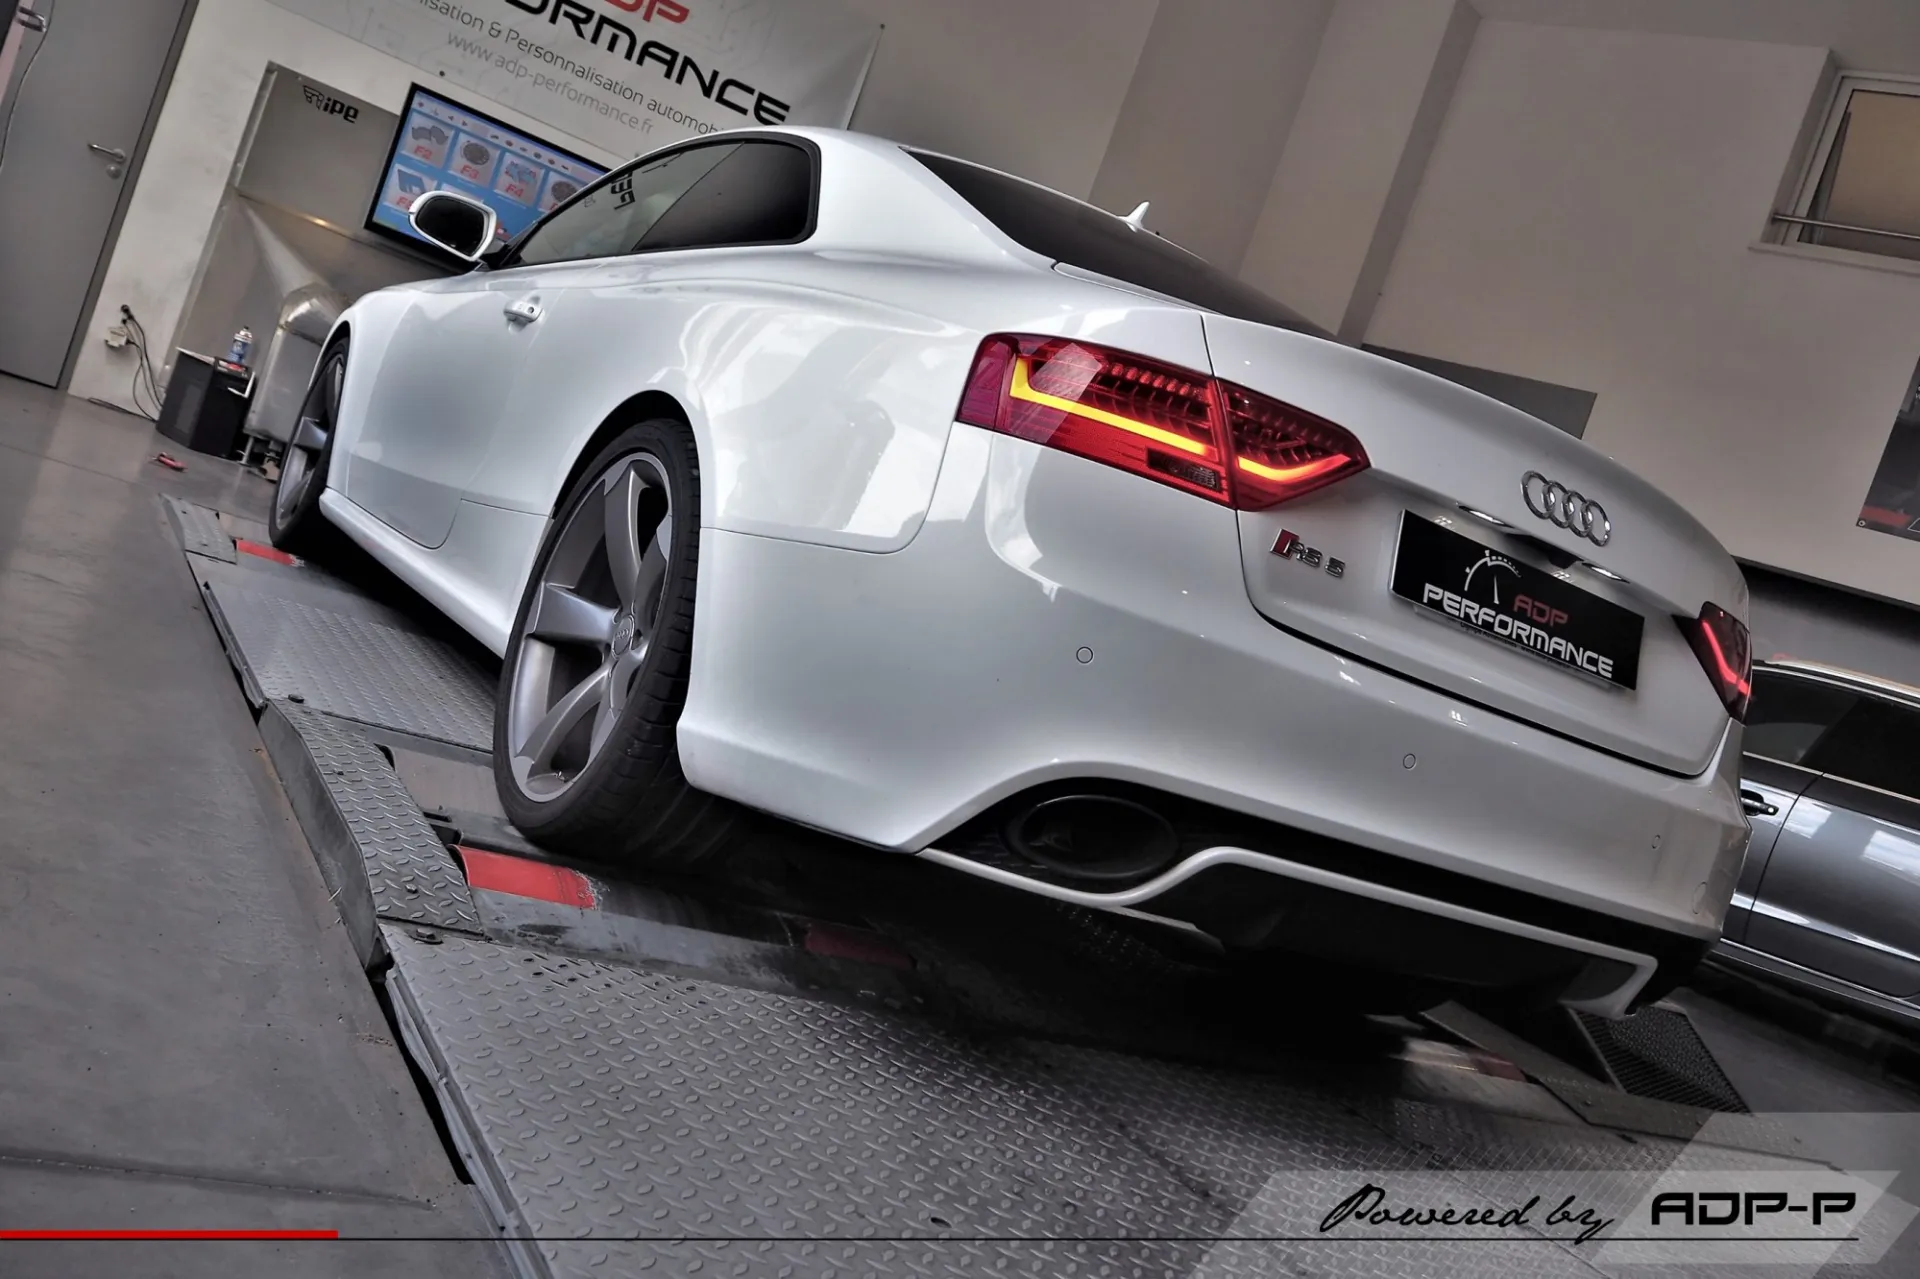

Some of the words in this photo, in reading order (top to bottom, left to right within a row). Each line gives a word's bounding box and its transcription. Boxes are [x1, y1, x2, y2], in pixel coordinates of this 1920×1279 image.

[488, 21, 502, 39] &
[505, 28, 644, 106] Personnalisation
[413, 144, 434, 159] F2
[459, 164, 480, 180] F3
[504, 183, 525, 198] F4
[1283, 538, 1323, 569] RS
[1324, 556, 1346, 579] 5
[1513, 594, 1569, 628] ADP
[1422, 582, 1614, 679] PERFORMANCE
